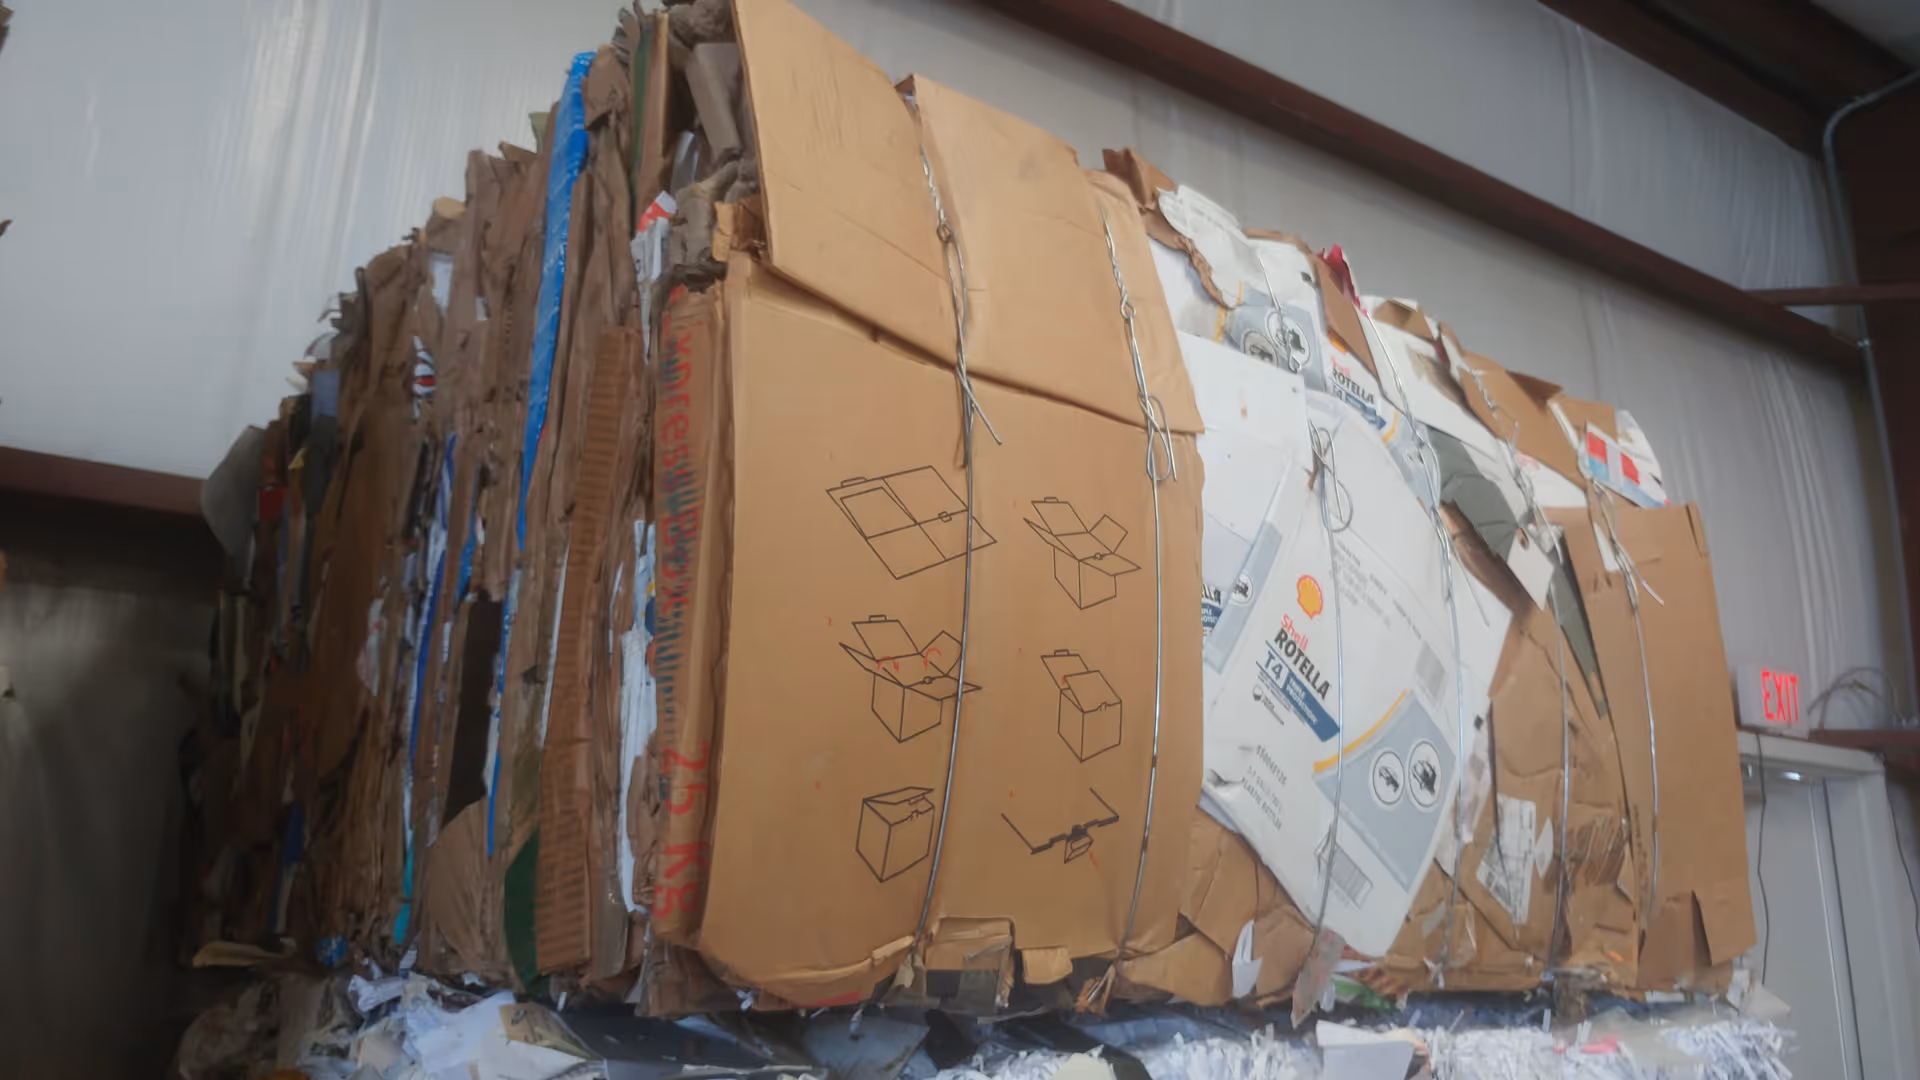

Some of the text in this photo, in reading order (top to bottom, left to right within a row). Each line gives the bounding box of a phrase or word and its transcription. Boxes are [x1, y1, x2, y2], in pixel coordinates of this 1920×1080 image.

[1280, 613, 1309, 651] Shell
[1264, 650, 1284, 680] T4
[1274, 627, 1331, 700] ROTELLA
[1761, 670, 1799, 725] EXIT
[652, 740, 711, 919] 25 Kg
